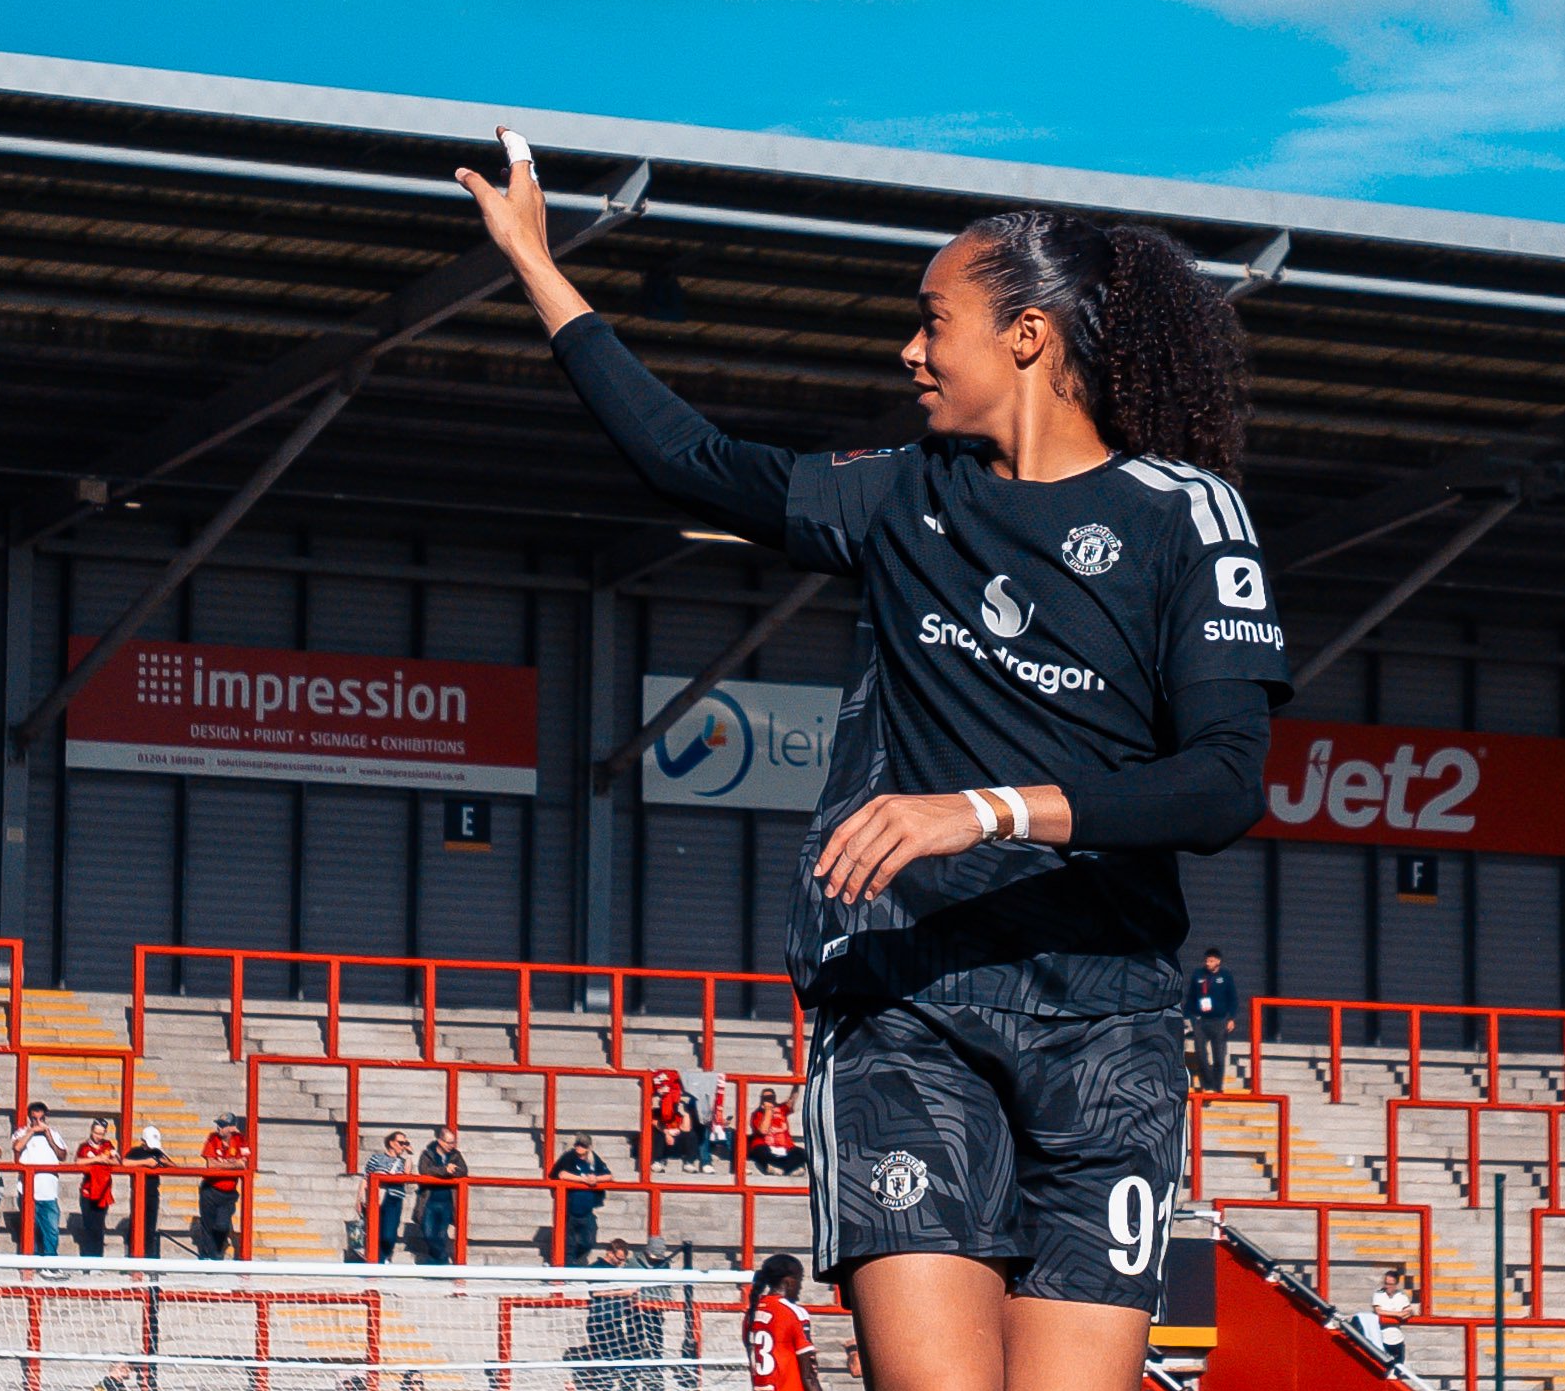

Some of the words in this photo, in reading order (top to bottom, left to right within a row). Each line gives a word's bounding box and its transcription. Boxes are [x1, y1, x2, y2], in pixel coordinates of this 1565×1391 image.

[1204, 619, 1284, 651] sumup
[193, 657, 467, 723] impression
[190, 724, 240, 741] DESIGN
[254, 730, 294, 744] PRINT
[310, 732, 367, 749] SIGNAGE
[381, 736, 465, 755] EXHIBITIONS
[769, 711, 833, 767] lei
[1268, 738, 1481, 833] Jet2
[461, 807, 474, 836] E
[1413, 861, 1424, 889] F
[875, 1152, 923, 1176] MANCHESTER
[882, 1195, 917, 1207] UNITED
